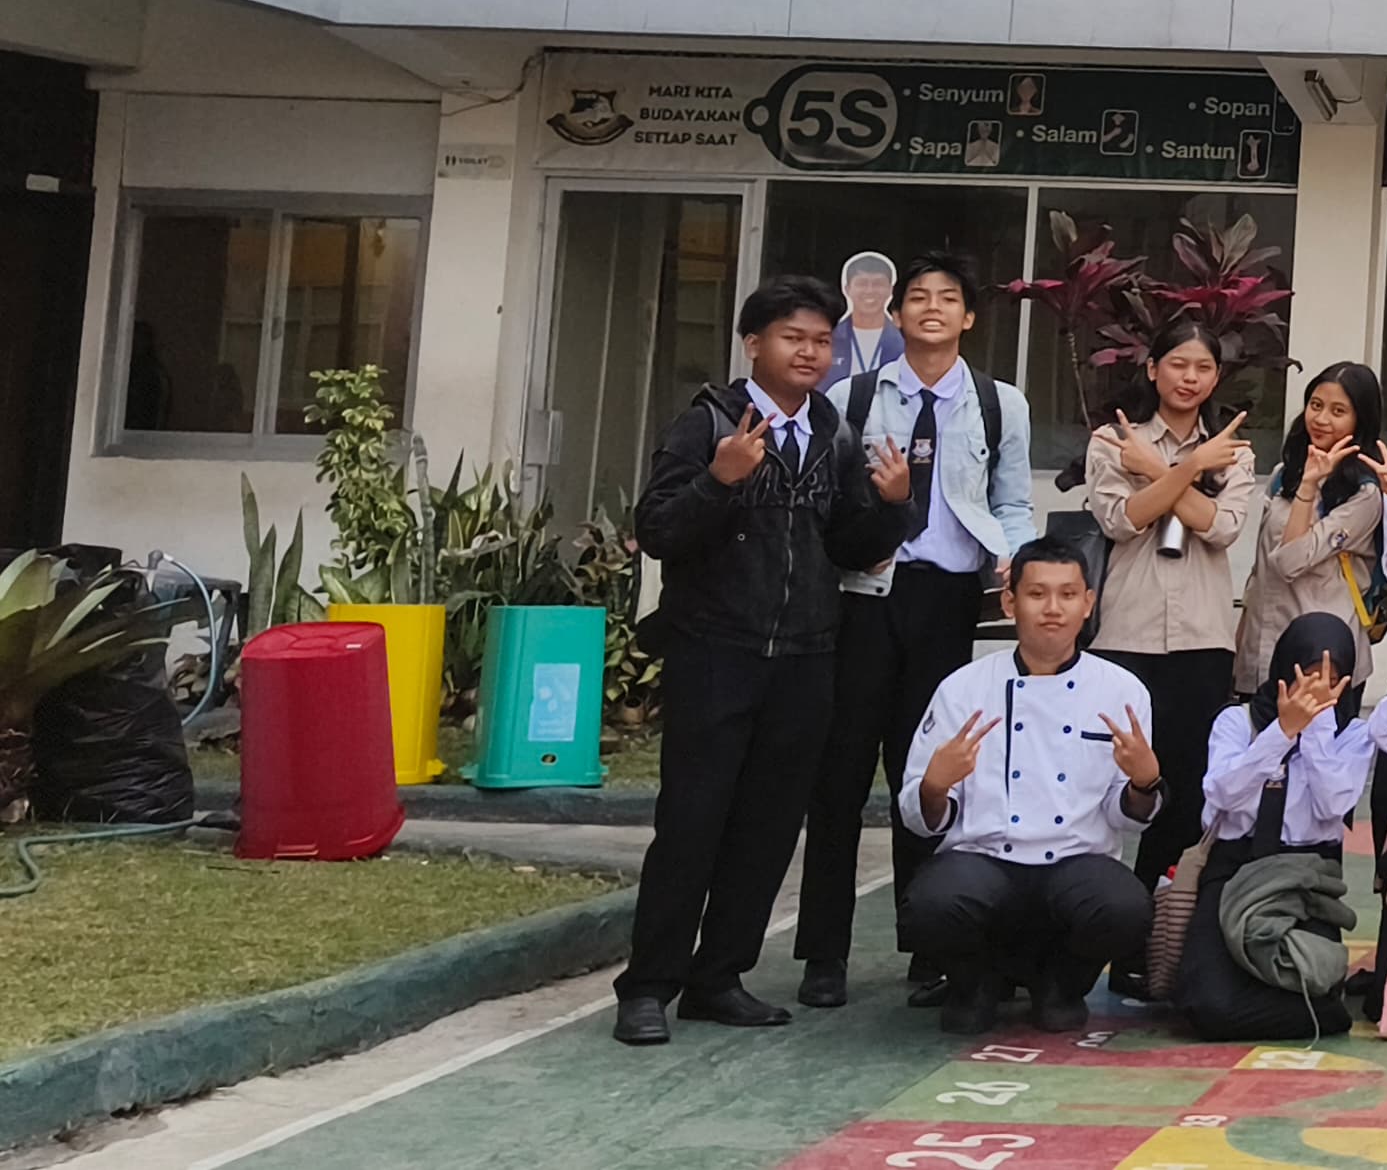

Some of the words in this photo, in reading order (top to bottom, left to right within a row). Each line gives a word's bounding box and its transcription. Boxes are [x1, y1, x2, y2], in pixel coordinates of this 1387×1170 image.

[649, 85, 691, 98] MARI
[695, 86, 733, 99] KITA
[918, 83, 1004, 106] Senyum
[639, 108, 740, 122] BUDAYAKAN
[787, 88, 888, 148] 5S
[1204, 97, 1271, 119] Sopan
[634, 131, 692, 145] SETIAP
[695, 133, 738, 146] SAAT
[1031, 124, 1097, 144] Salam
[908, 136, 962, 159] Sapa
[1161, 141, 1235, 160] Santun
[971, 1044, 1044, 1063] 27
[936, 1081, 1030, 1106] 26
[886, 1133, 1036, 1170] 25
